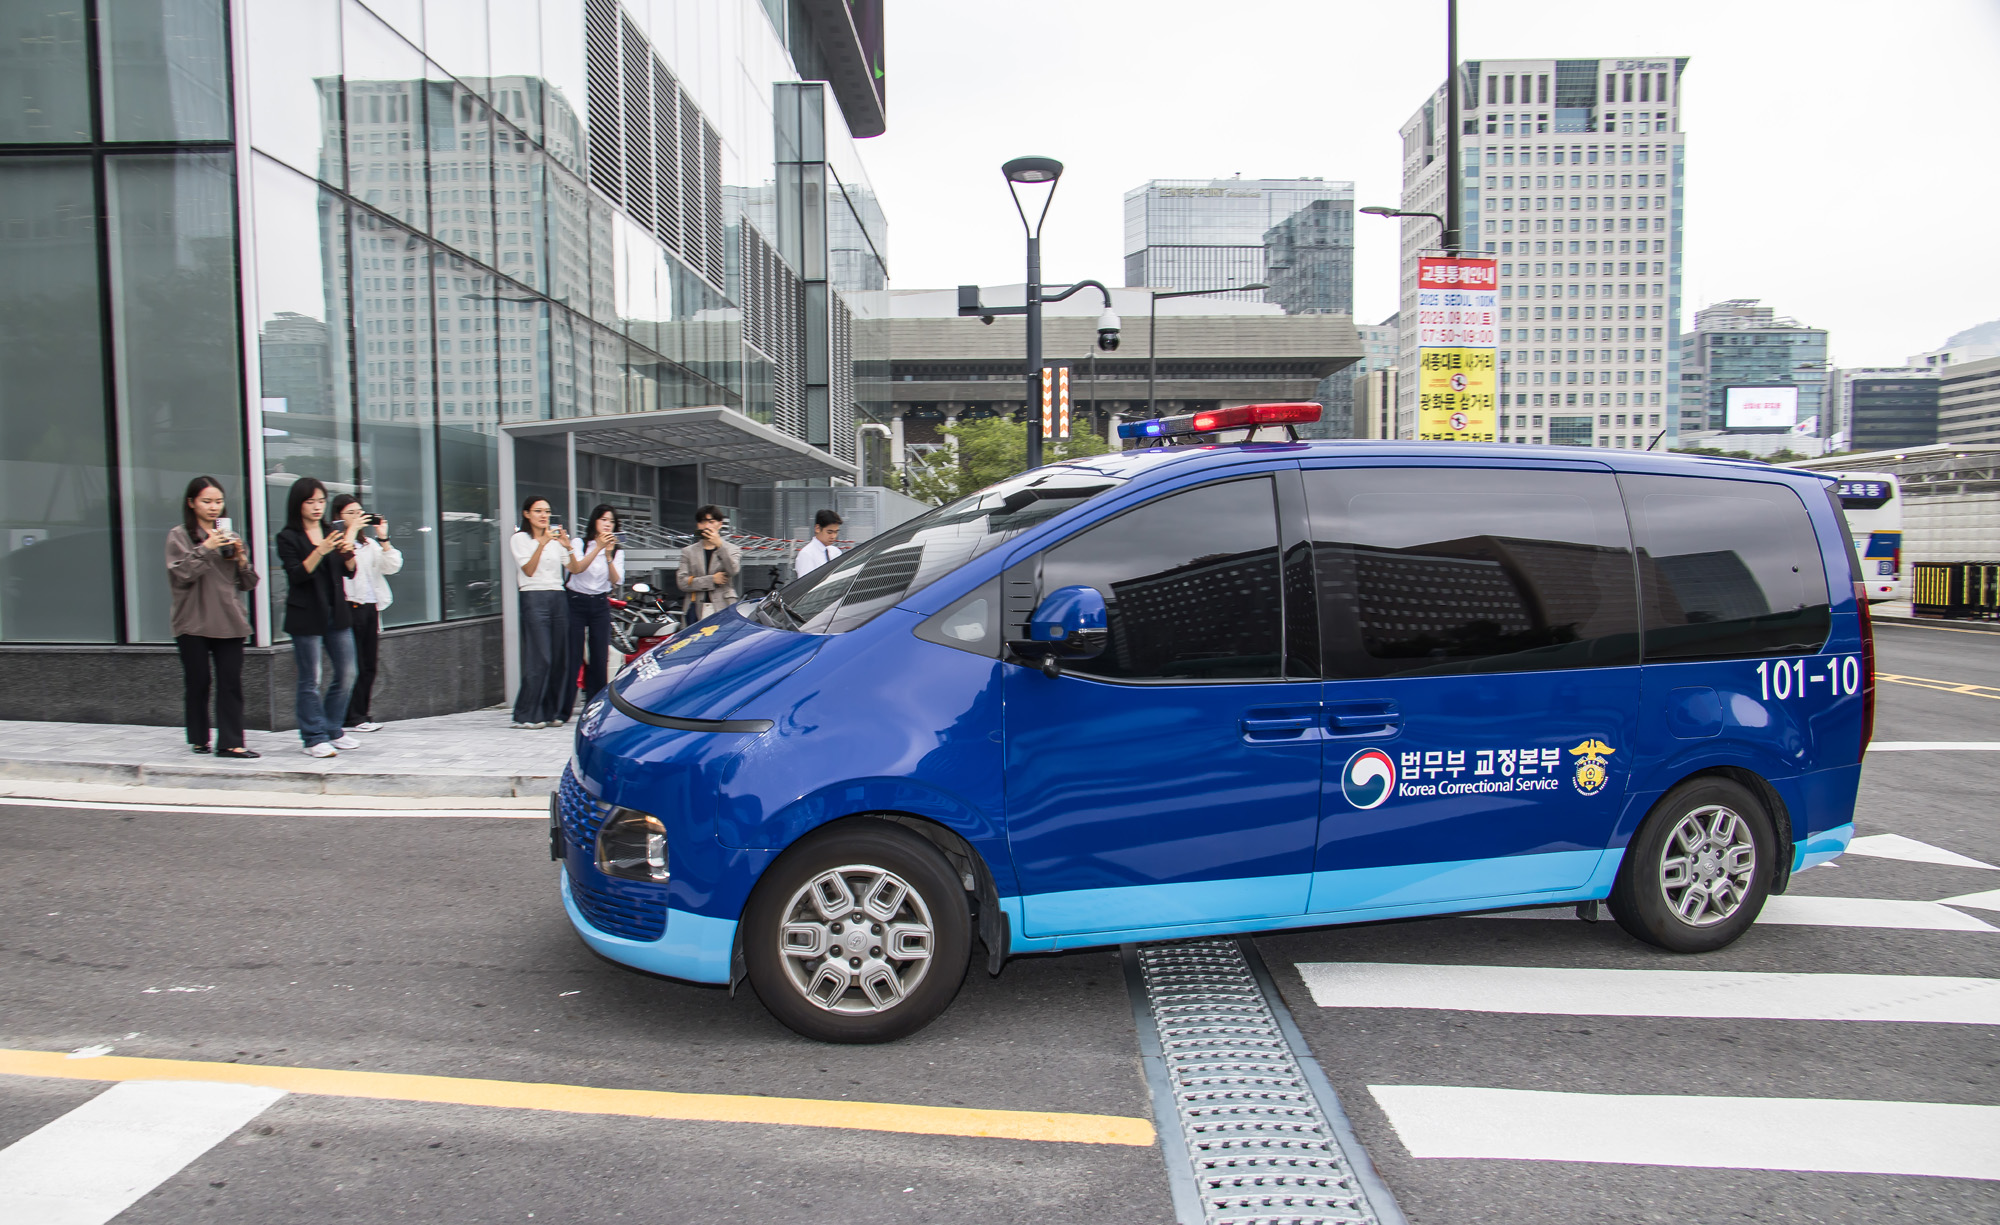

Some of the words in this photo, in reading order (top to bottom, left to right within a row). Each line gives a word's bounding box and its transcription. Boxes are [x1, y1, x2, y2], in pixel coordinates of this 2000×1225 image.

[1420, 265, 1495, 284] 교통통제안내
[1419, 293, 1439, 306] 2025
[1444, 293, 1472, 307] SEOUL
[1420, 393, 1455, 411] 광화문
[1755, 655, 1859, 701] 101-10
[1400, 750, 1466, 780] 법무부
[1473, 747, 1560, 776] 교정본부
[1399, 782, 1436, 797] Korea
[1438, 777, 1514, 795] Correctional
[1515, 776, 1559, 792] Service
